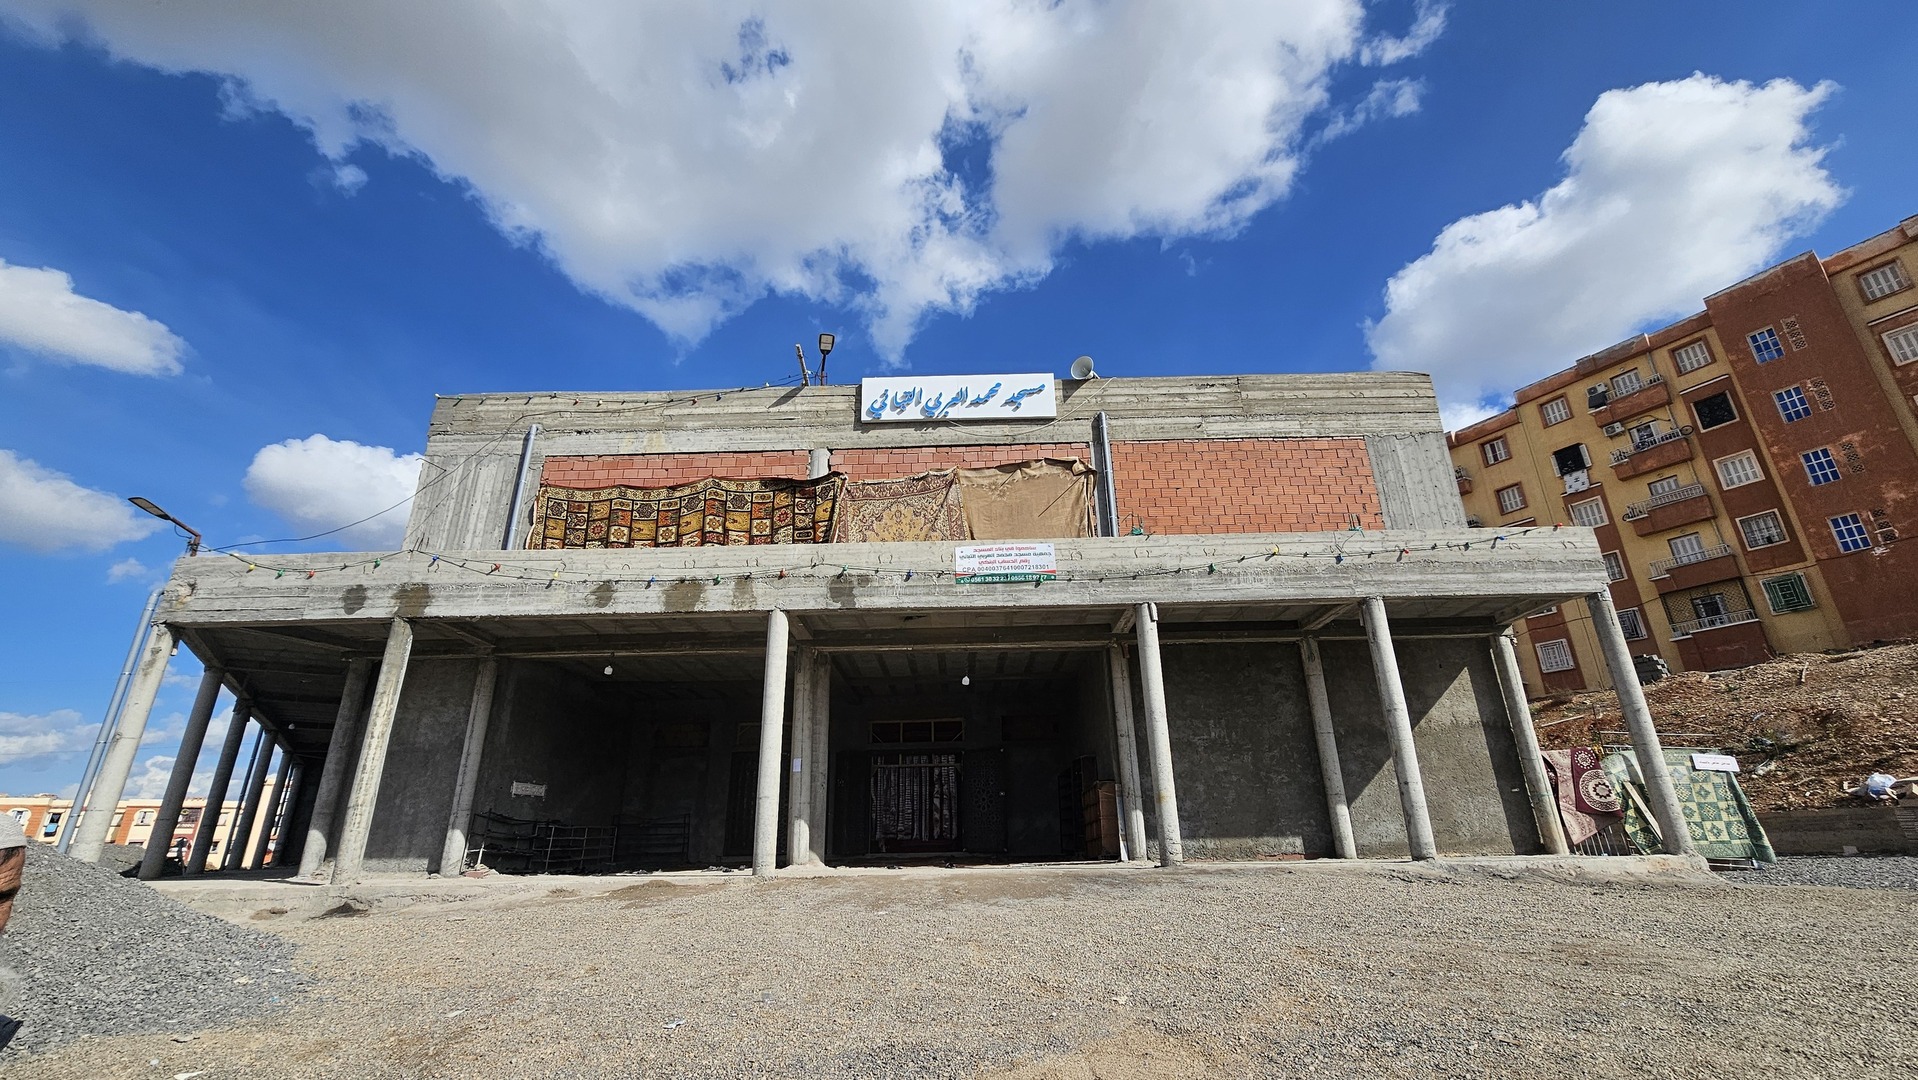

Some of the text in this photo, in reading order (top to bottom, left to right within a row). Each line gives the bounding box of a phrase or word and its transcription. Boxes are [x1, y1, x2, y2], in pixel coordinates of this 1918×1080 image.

[922, 386, 969, 419] العربي
[967, 382, 1002, 407] محمد
[1000, 383, 1046, 411] مسجد
